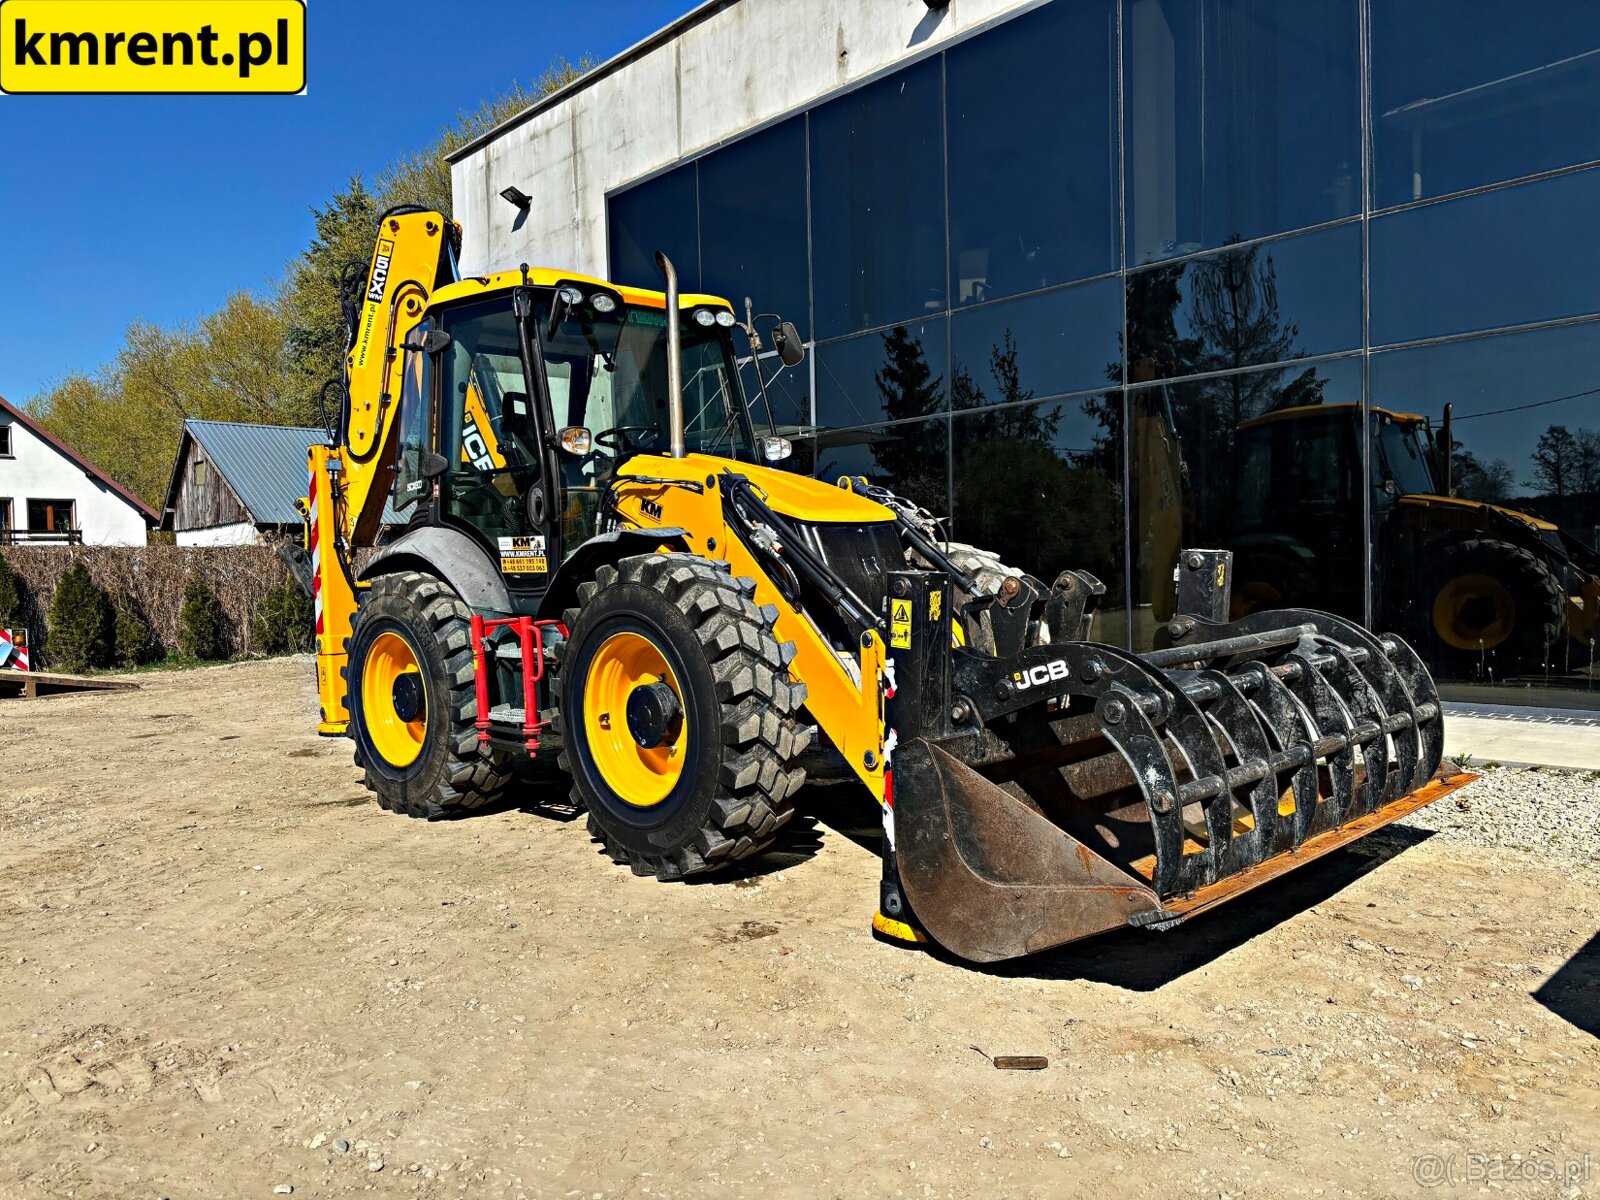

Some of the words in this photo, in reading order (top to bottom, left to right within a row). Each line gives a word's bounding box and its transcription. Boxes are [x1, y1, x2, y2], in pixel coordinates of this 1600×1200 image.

[359, 303, 376, 366] www.kmrent.pl
[640, 497, 662, 519] KM
[512, 537, 531, 547] KM
[1015, 660, 1069, 690] JCB
